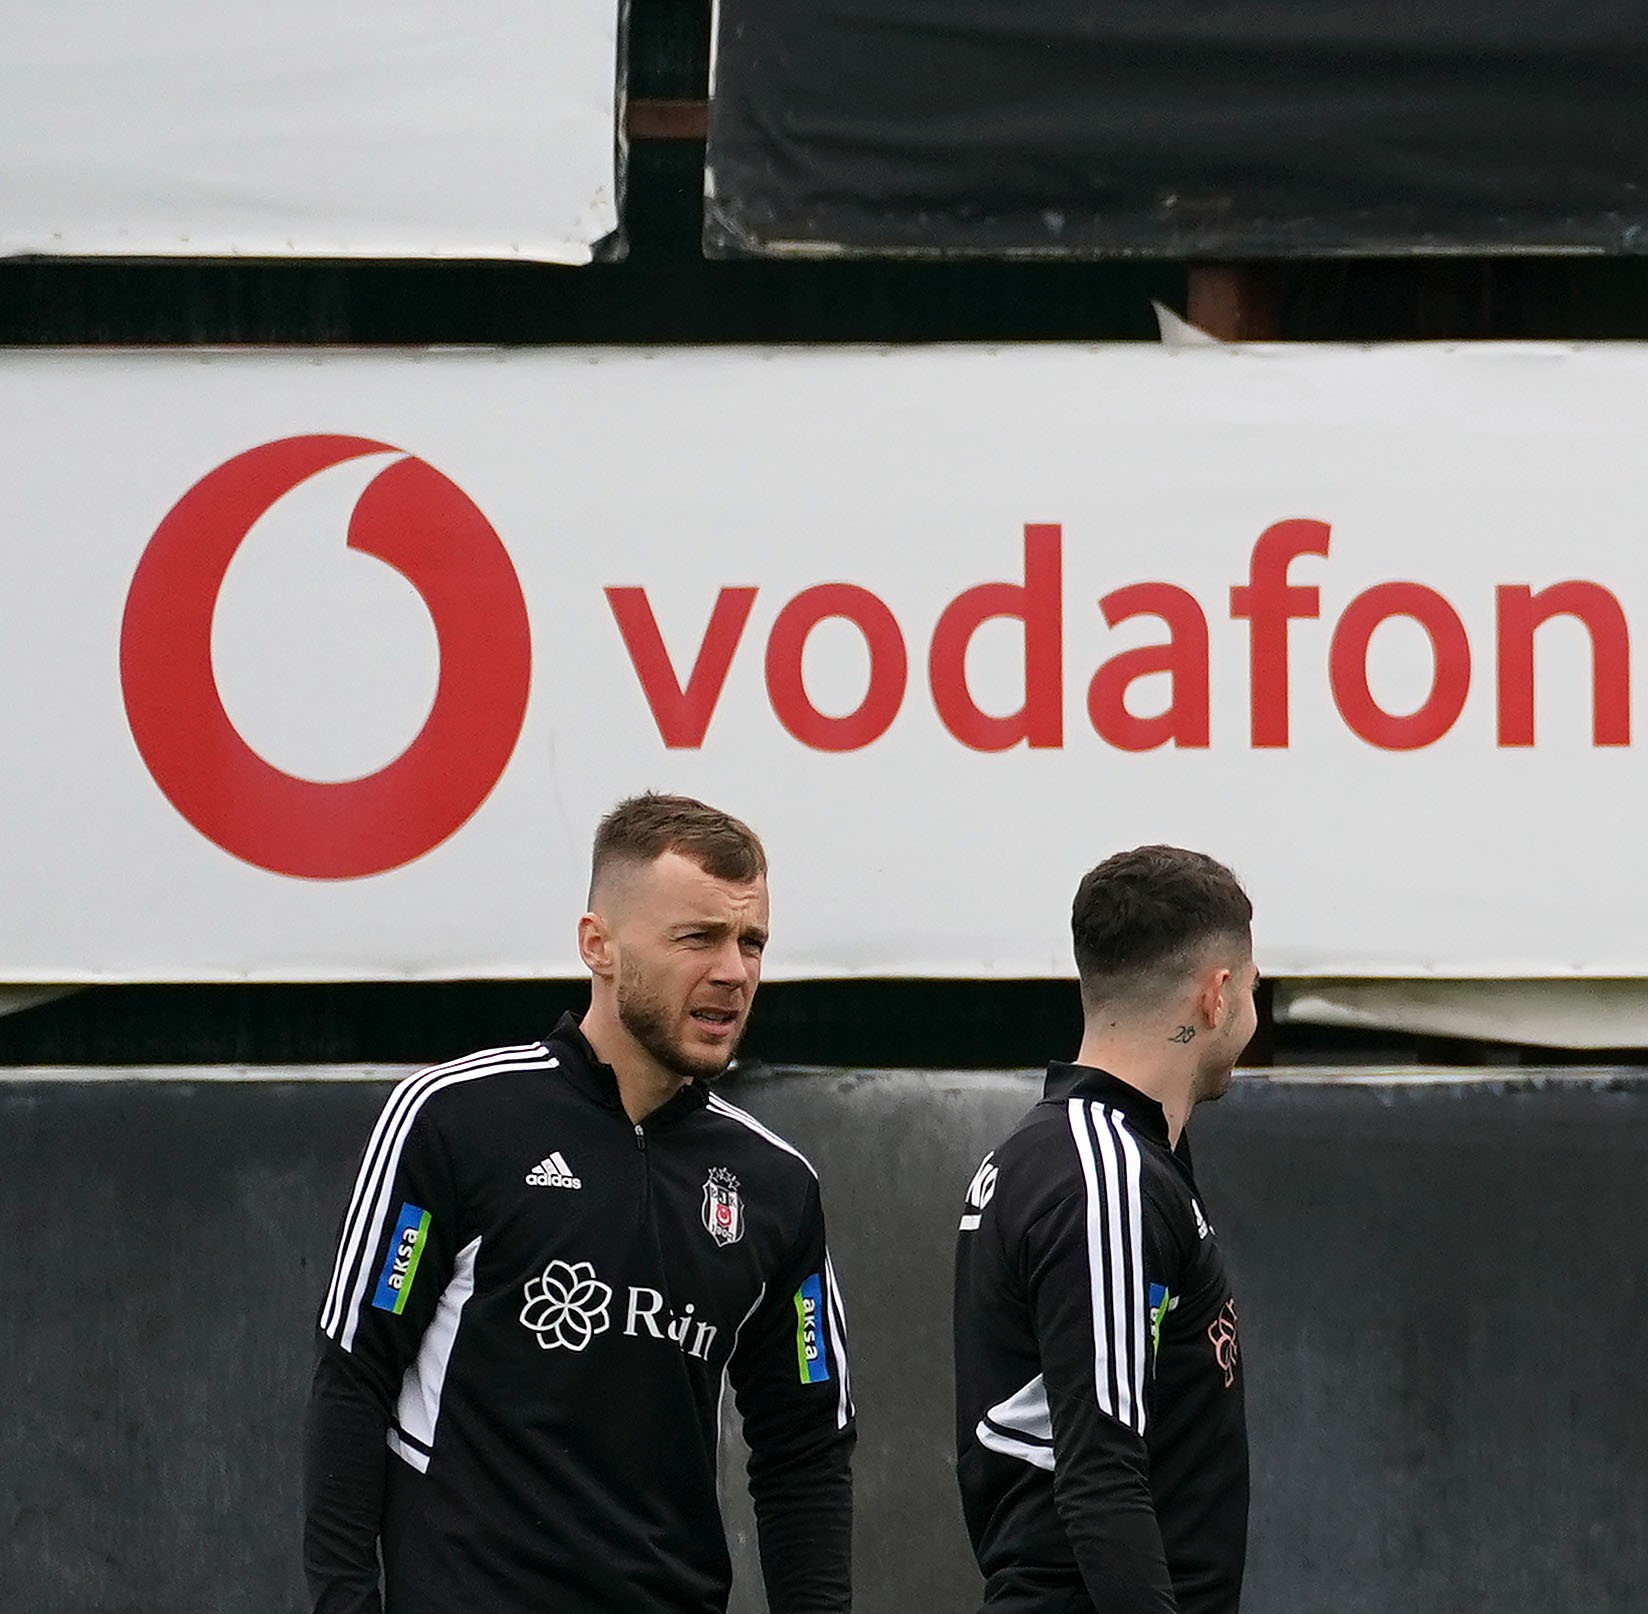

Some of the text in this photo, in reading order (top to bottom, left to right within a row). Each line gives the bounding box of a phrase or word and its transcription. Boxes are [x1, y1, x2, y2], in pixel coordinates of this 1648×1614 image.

[525, 1173, 582, 1190] adidas
[387, 1227, 419, 1290] aksa
[803, 1297, 819, 1361] aksa
